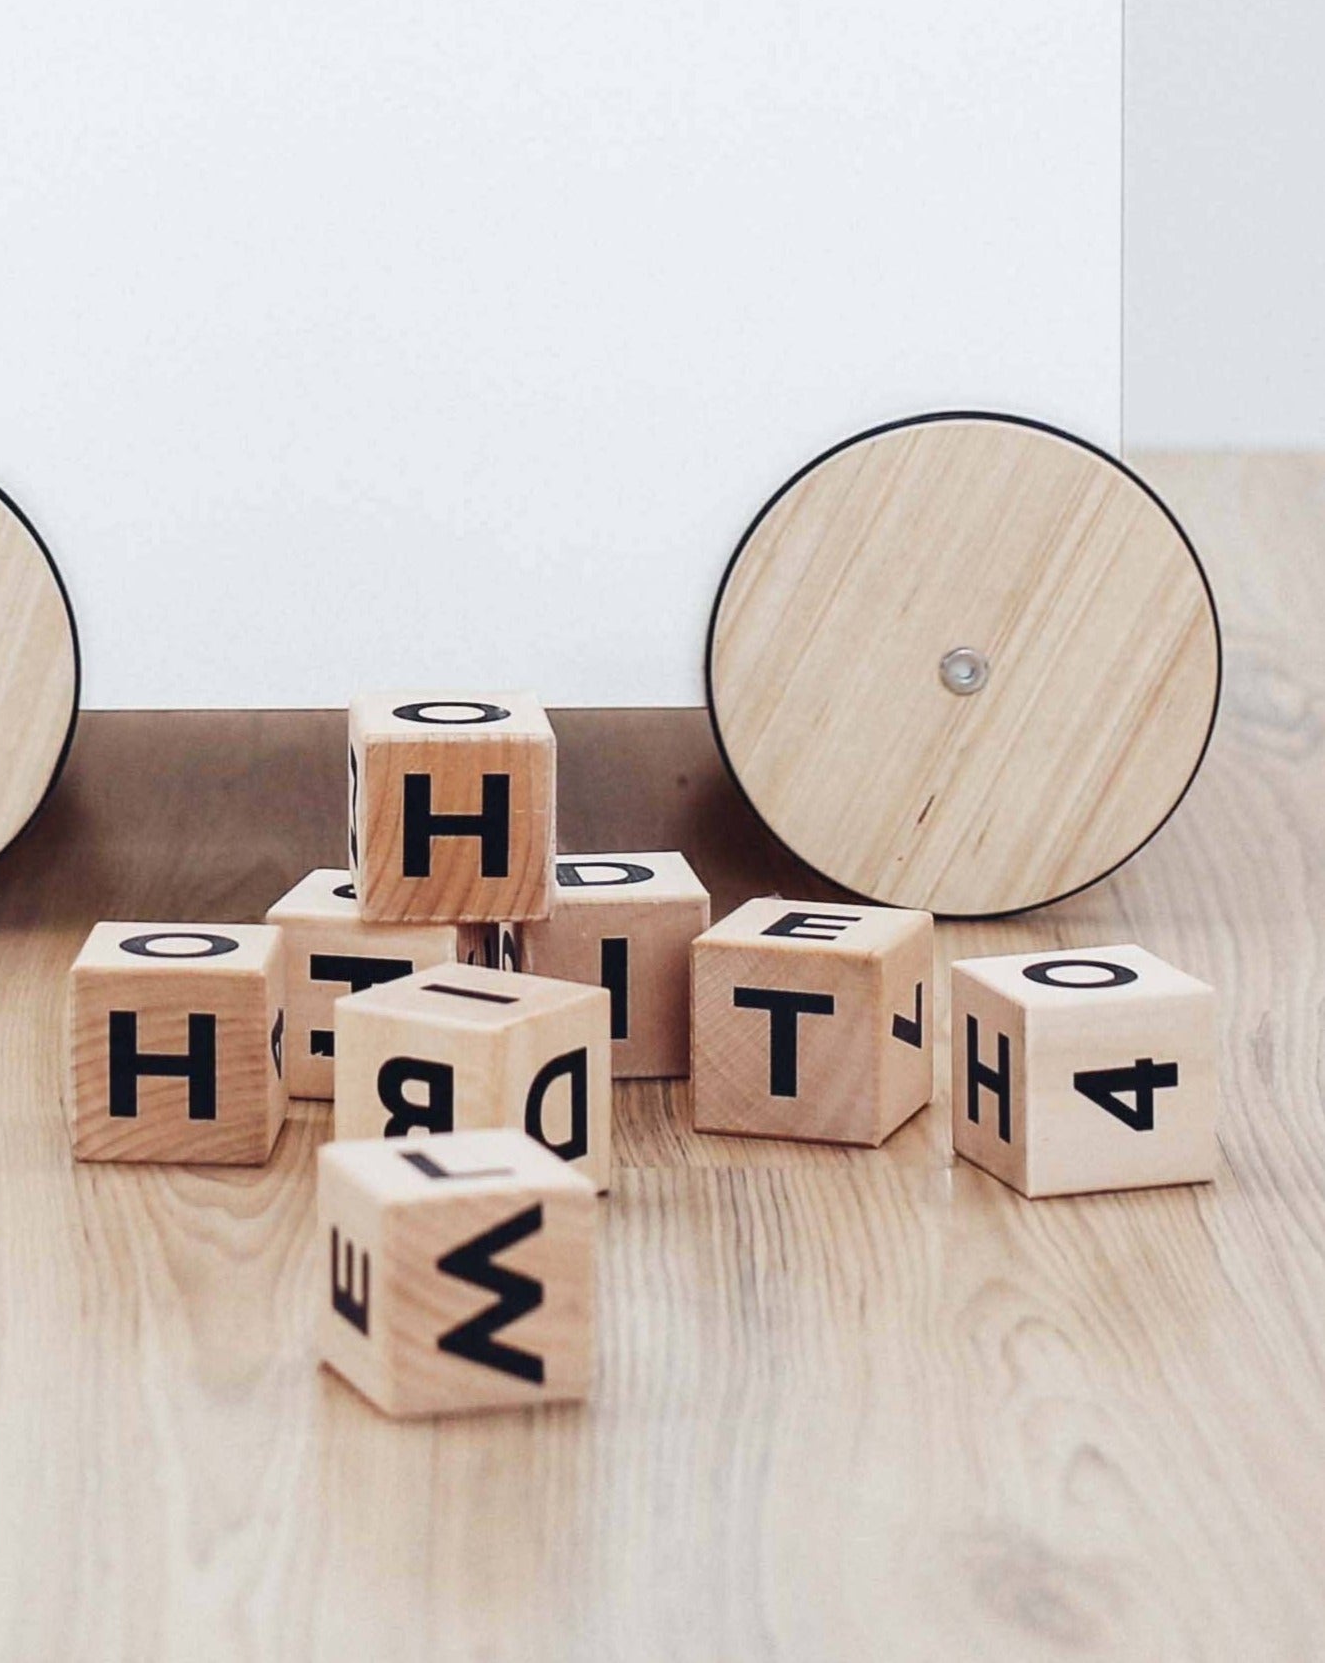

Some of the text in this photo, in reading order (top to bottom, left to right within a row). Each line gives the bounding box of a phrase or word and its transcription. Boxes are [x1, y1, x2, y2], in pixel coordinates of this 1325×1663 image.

[403, 774, 509, 877] H
[556, 862, 654, 886] D
[761, 912, 861, 940] E
[109, 1011, 216, 1120] H
[734, 987, 834, 1097] T
[967, 1014, 1010, 1143] H
[1074, 1058, 1178, 1131] 4
[331, 1226, 369, 1337] E
